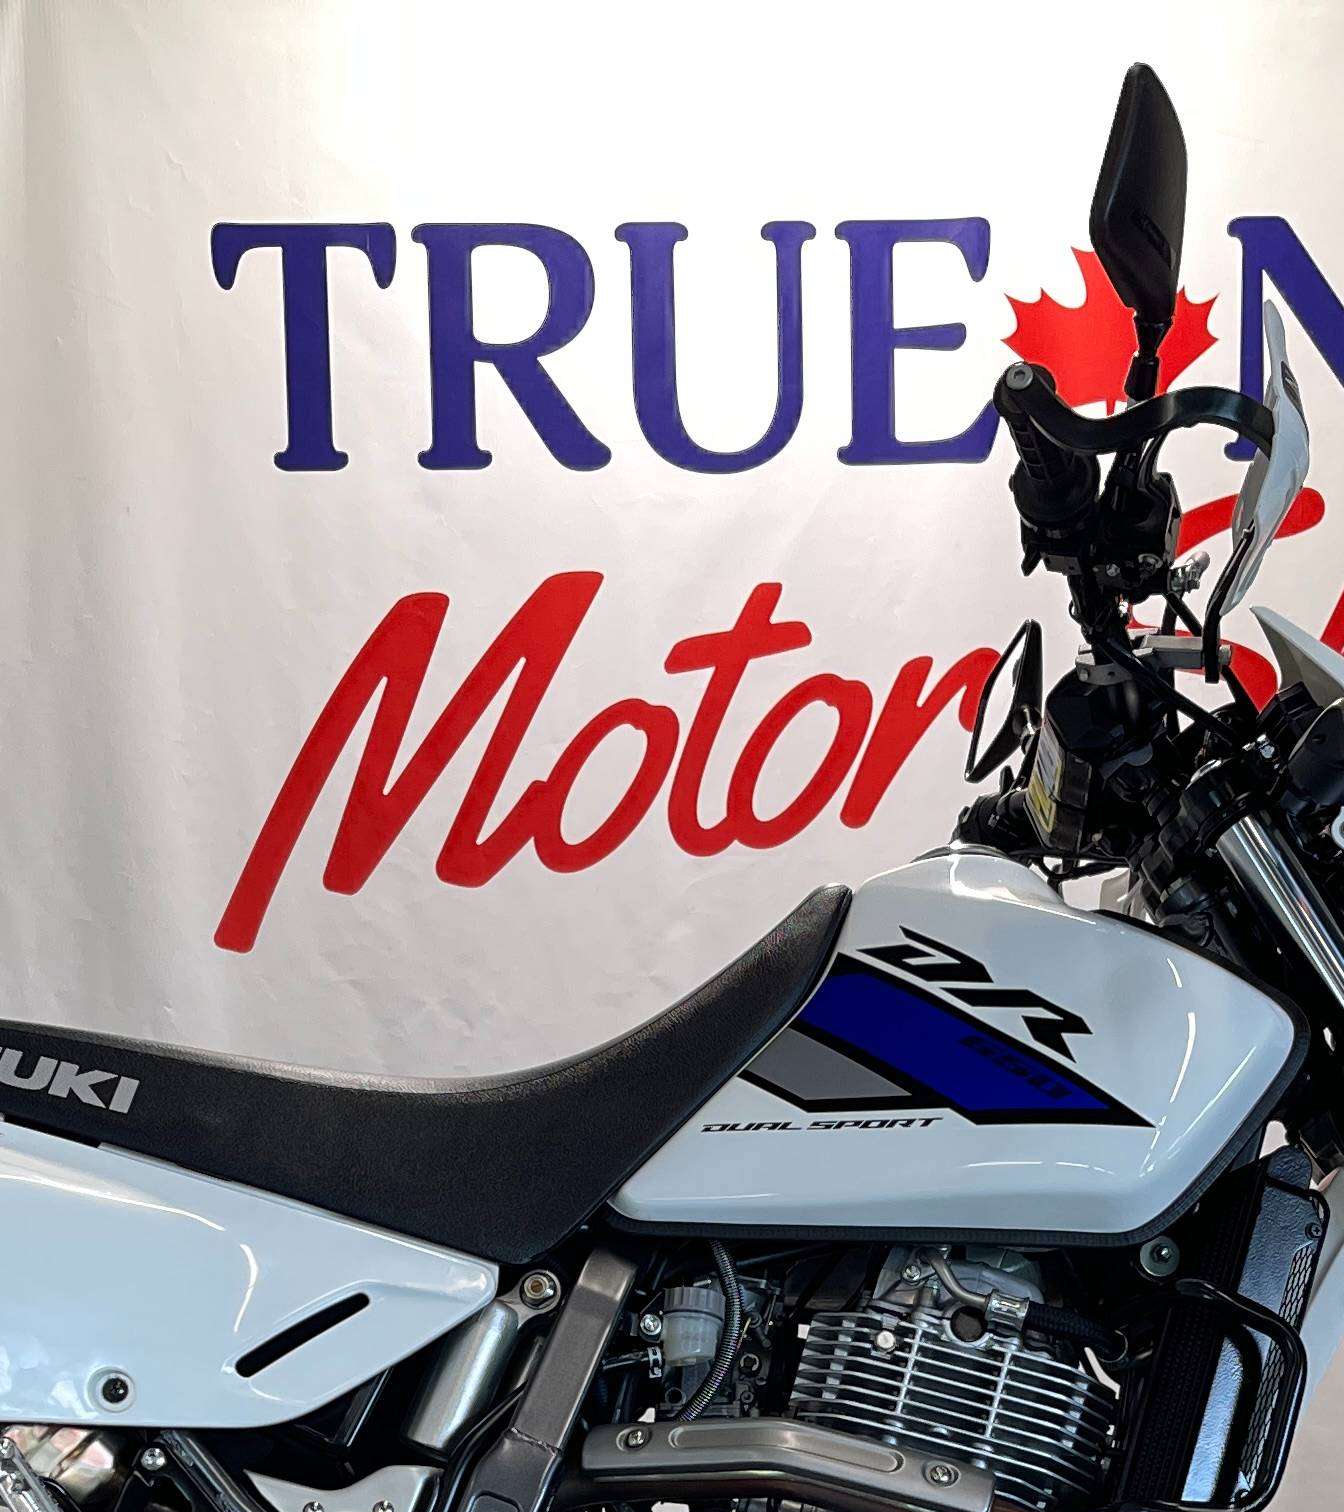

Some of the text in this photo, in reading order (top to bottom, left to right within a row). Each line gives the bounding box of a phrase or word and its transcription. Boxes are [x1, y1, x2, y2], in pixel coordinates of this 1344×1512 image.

[211, 220, 994, 474] TRUE
[213, 570, 1003, 953] Motor
[700, 1117, 944, 1134] DUAL SPORT
[959, 1036, 1073, 1100] 650
